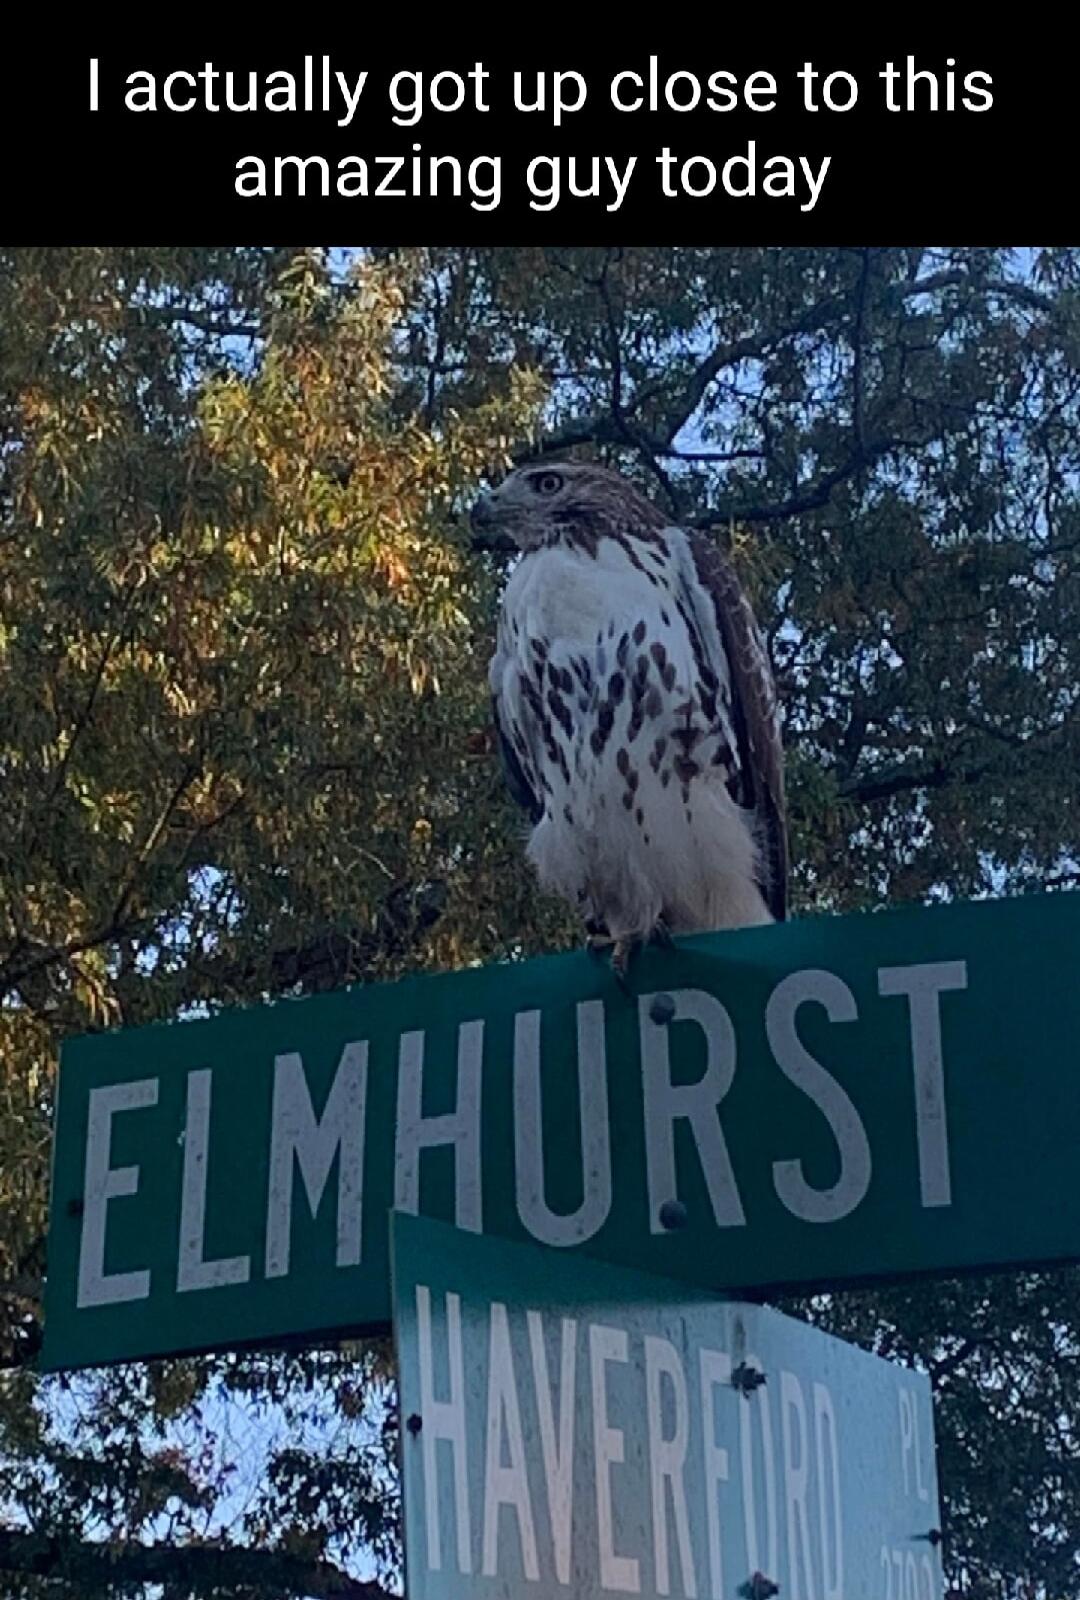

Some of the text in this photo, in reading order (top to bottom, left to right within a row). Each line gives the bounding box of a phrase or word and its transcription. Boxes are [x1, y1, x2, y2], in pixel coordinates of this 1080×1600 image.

[77, 960, 967, 1308] ELMHURST
[415, 1285, 929, 1600] HAVERFORD PL
